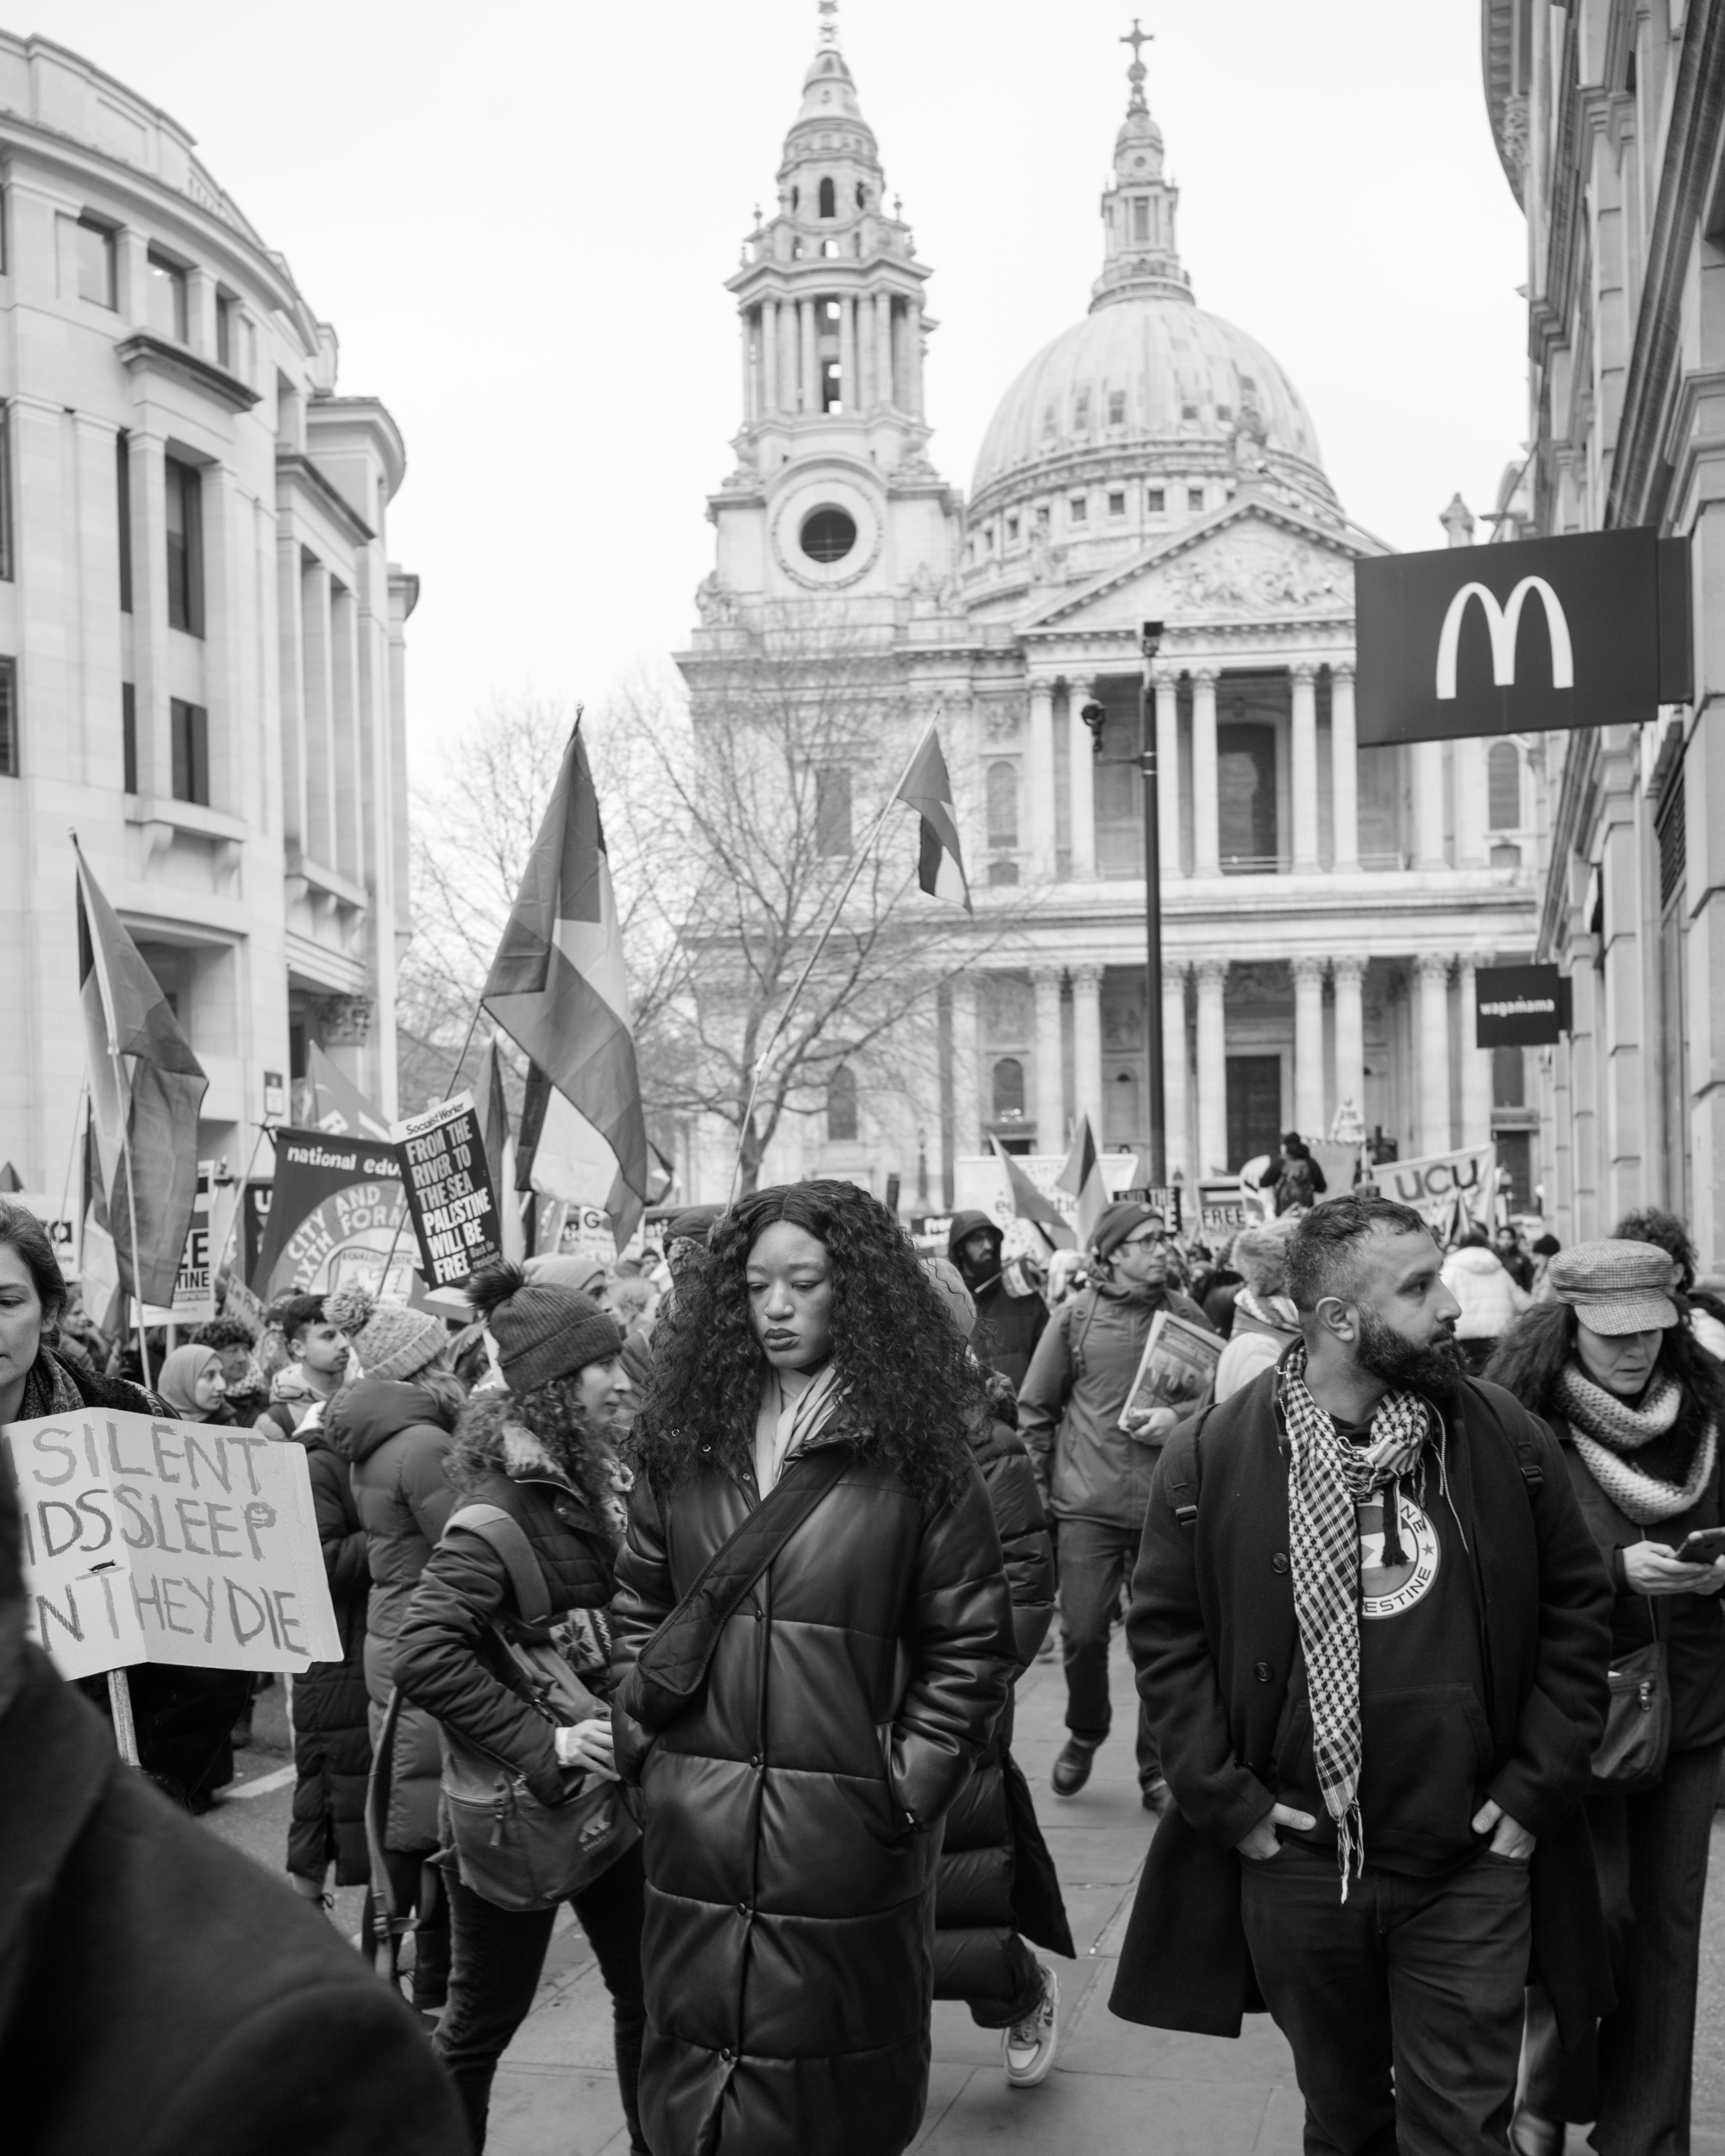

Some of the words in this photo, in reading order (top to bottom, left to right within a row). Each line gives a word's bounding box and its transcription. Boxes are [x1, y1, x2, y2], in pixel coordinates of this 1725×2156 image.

[1479, 998, 1555, 1018] wagamama
[438, 1103, 464, 1122] Worker
[286, 1145, 357, 1171] national
[362, 1157, 402, 1178] edu
[405, 1129, 447, 1165] FROM
[445, 1116, 473, 1148] THE
[411, 1153, 454, 1189] RIVER
[452, 1143, 472, 1171] TO
[1394, 1158, 1478, 1201] UCU
[416, 1181, 449, 1213] THE
[446, 1170, 474, 1200] SEA
[422, 1187, 492, 1237] PALESTINE
[287, 1207, 327, 1261] CITY
[335, 1185, 380, 1218] AND
[1202, 1208, 1245, 1224] FREE
[426, 1227, 465, 1260] WILL
[461, 1218, 486, 1247] BE
[291, 1230, 336, 1293] IXTH
[433, 1250, 471, 1284] FREE
[32, 1421, 268, 1495] SILENT
[112, 1483, 278, 1562] SLEEP
[74, 1566, 215, 1644] THEY
[223, 1576, 312, 1658] DIE
